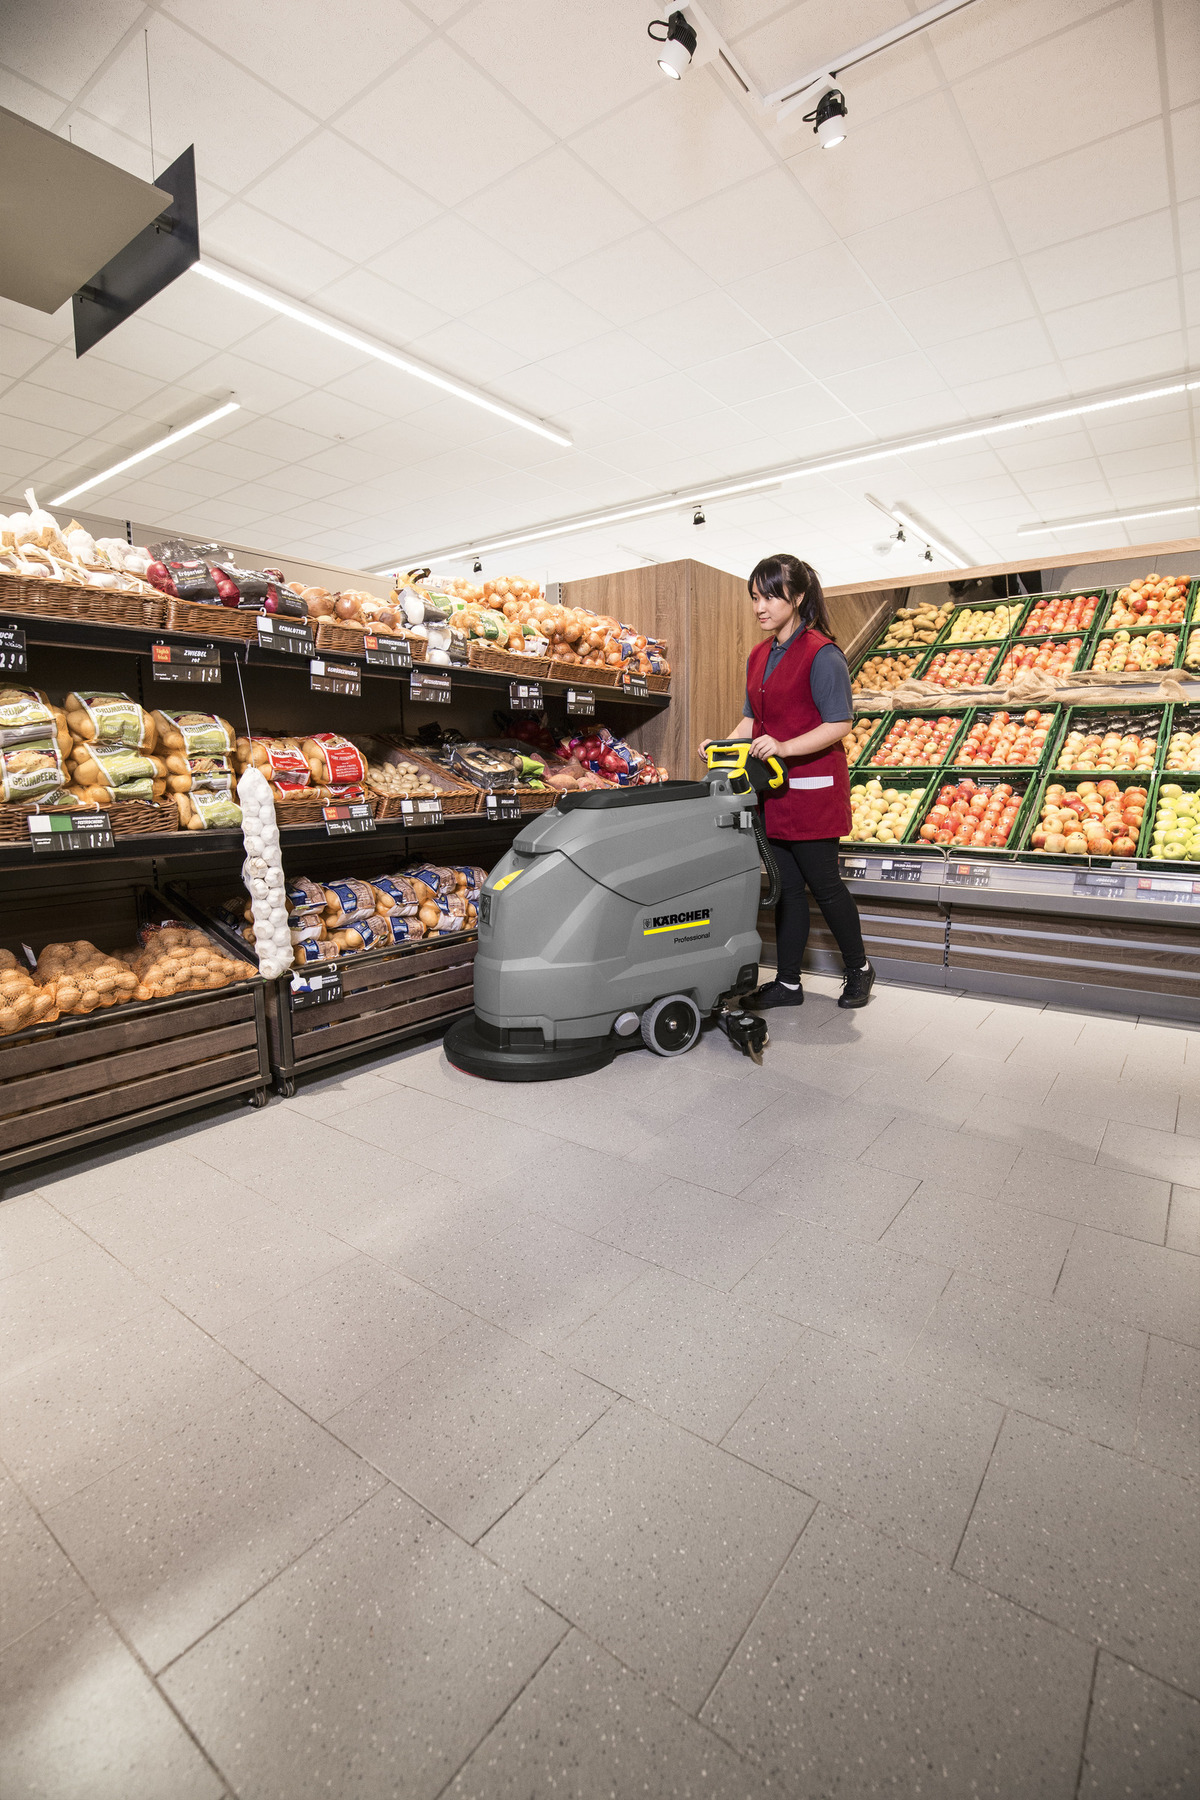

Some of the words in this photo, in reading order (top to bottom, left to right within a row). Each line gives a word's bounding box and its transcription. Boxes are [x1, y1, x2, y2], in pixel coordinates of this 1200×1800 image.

[184, 649, 207, 658] ZWIEBEL
[95, 703, 136, 713] GRUMBEERE
[12, 773, 58, 788] GRUMBEERE
[653, 909, 710, 928] KÄRCHER
[673, 932, 711, 944] Professional
